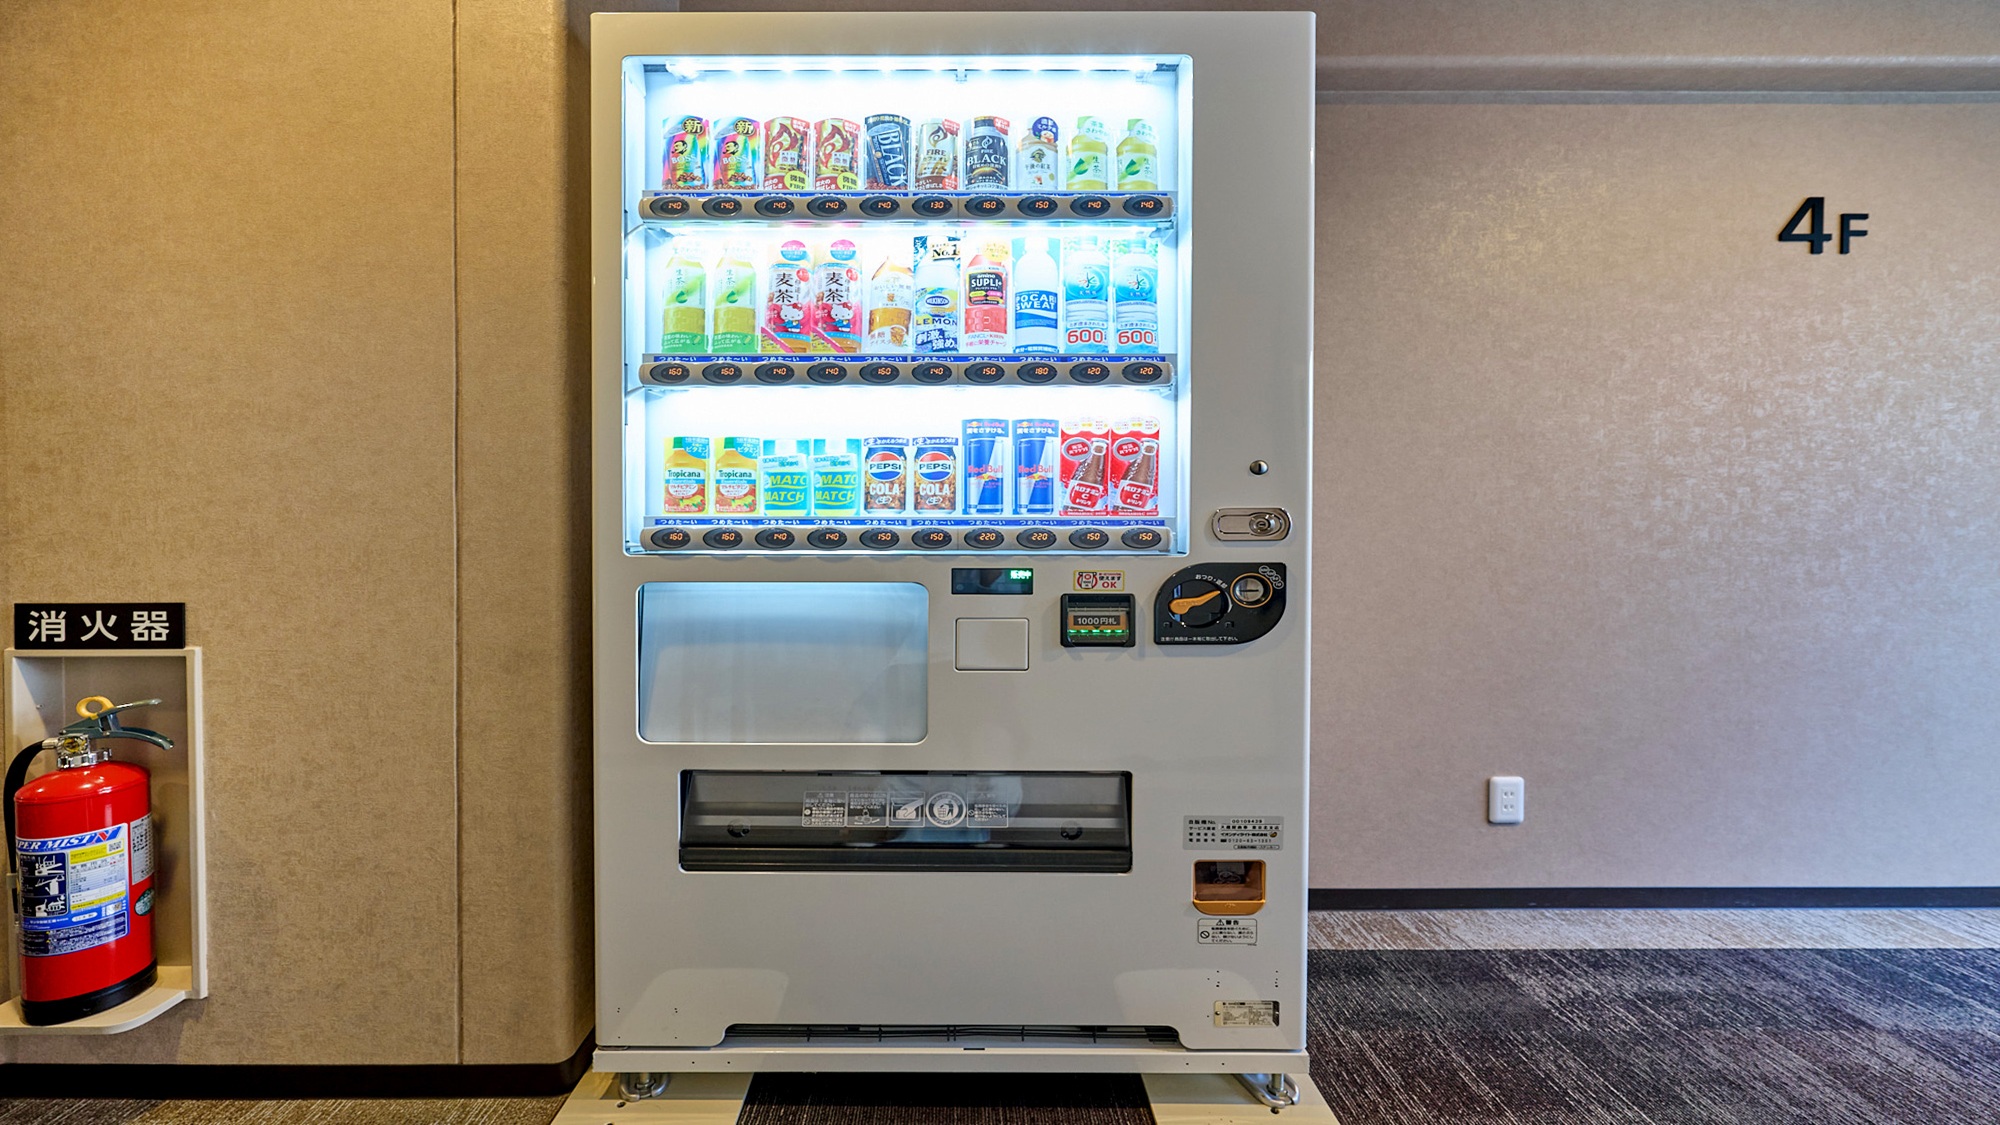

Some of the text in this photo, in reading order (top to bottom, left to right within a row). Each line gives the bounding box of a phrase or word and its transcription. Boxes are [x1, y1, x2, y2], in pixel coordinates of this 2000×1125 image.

[684, 119, 701, 134] 新
[735, 120, 753, 135] 新
[926, 148, 947, 157] FIRE
[671, 155, 697, 164] BOSS
[722, 154, 746, 165] BOSS
[877, 130, 909, 187] BLACK
[966, 154, 1007, 166] BLACK
[668, 201, 683, 210] 140
[720, 201, 735, 210] 140
[773, 201, 787, 210] 140
[825, 201, 839, 210] 140
[878, 201, 892, 210] 140
[930, 201, 944, 210] 130
[983, 201, 997, 210] 160
[1035, 201, 1049, 210] 150
[1088, 201, 1102, 210] 140
[1140, 201, 1154, 210] 140
[1777, 196, 1870, 255] 4F
[775, 272, 794, 303] 麦茶
[825, 271, 844, 303] 麦茶
[1015, 293, 1057, 304] POCARI
[1015, 301, 1055, 310] SWEAT
[915, 317, 958, 327] LEMON
[1067, 329, 1104, 344] 600
[1118, 330, 1154, 344] 600
[773, 367, 787, 376] 140
[825, 367, 839, 376] 140
[930, 367, 944, 376] 140
[983, 367, 997, 376] 150
[1035, 367, 1049, 376] 180
[1087, 367, 1101, 376] 120
[1140, 367, 1154, 376] 120
[968, 465, 1003, 473] Red Bull
[1018, 465, 1053, 473] Red Bull
[667, 469, 701, 479] Tropicana
[718, 469, 753, 479] Tropicana
[869, 483, 900, 495] COLA
[919, 483, 950, 495] COLA
[764, 491, 805, 501] MATCH
[815, 490, 855, 501] MATCH
[669, 533, 683, 541] 160
[721, 533, 735, 541] 160
[773, 533, 787, 541] 140
[825, 533, 839, 541] 140
[878, 533, 892, 541] 150
[930, 533, 944, 541] 150
[979, 533, 996, 541] 220
[1031, 533, 1048, 541] 220
[1086, 533, 1101, 541] 150
[1139, 533, 1153, 541] 150
[1101, 581, 1117, 589] OK
[1077, 616, 1117, 625] 1000円札
[28, 610, 170, 642] 消火器
[43, 833, 95, 849] MIST
